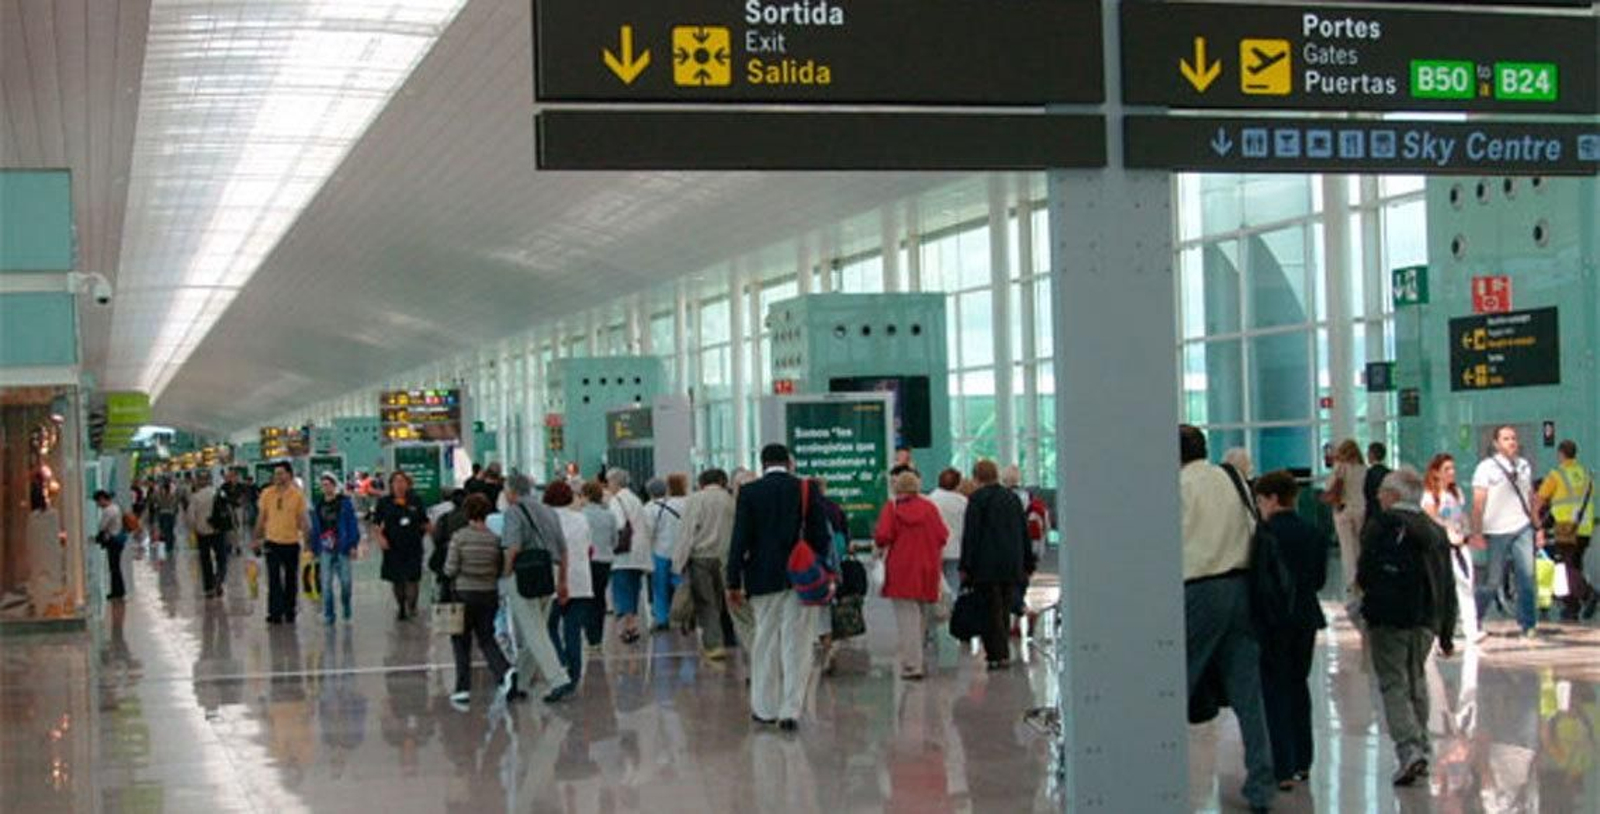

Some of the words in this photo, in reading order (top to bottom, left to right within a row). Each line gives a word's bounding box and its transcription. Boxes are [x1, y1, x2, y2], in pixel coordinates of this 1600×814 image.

[745, 0, 844, 25] Sortida
[1303, 14, 1382, 40] Portes
[745, 30, 786, 53] Exit
[1303, 43, 1359, 66] Gates
[746, 59, 832, 85] Salida
[1304, 71, 1398, 96] Puertas
[1417, 66, 1469, 92] B50
[1477, 64, 1492, 79] to
[1502, 68, 1551, 94] B24
[1402, 131, 1455, 165] Sky
[1466, 132, 1563, 161] Centre
